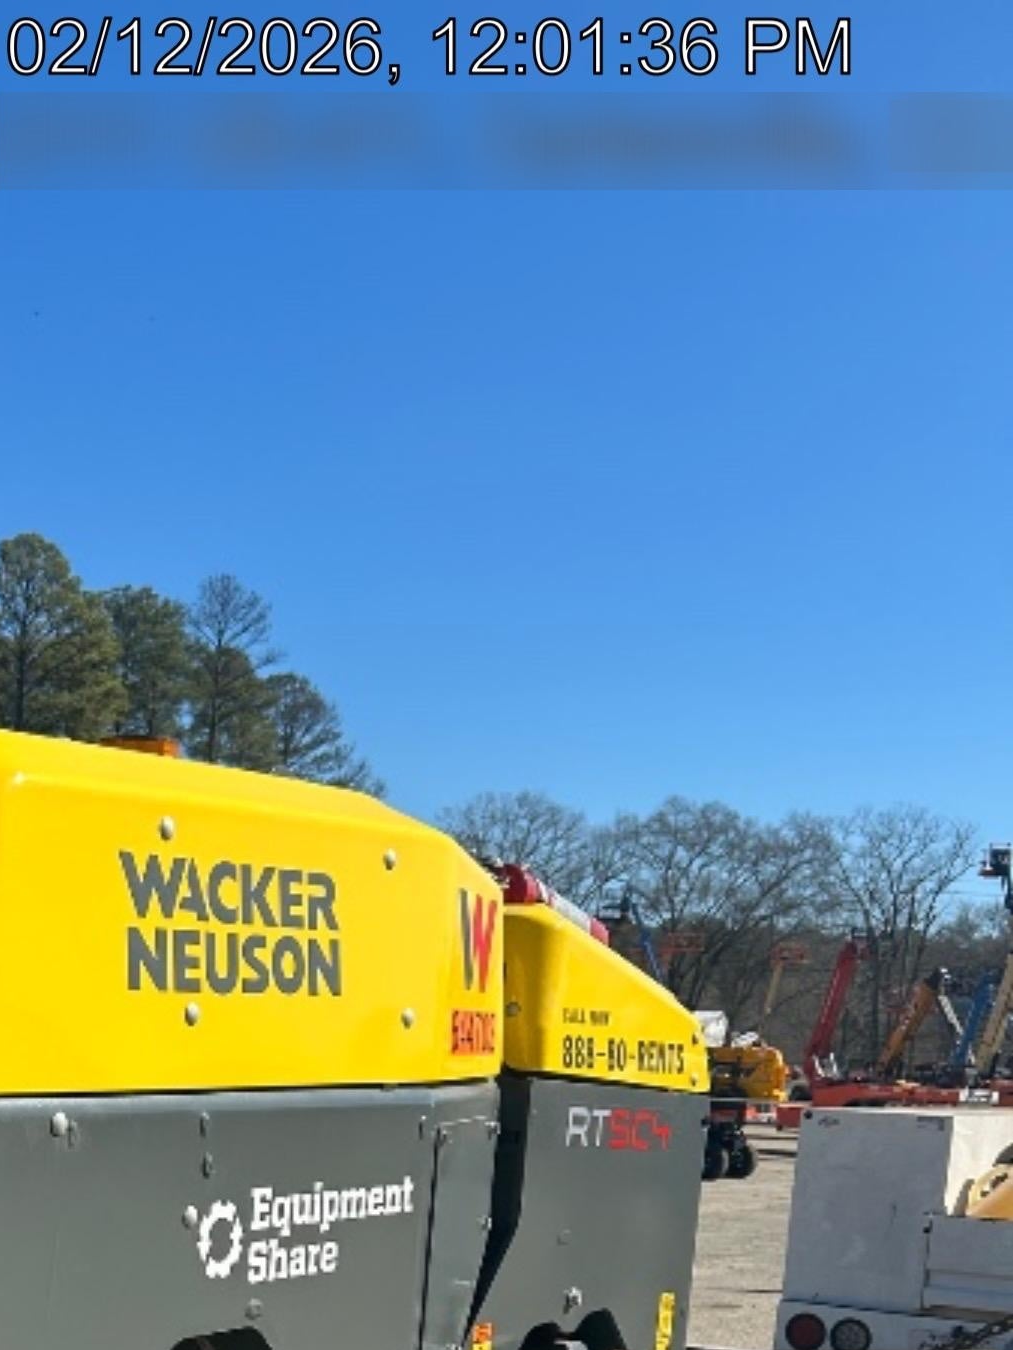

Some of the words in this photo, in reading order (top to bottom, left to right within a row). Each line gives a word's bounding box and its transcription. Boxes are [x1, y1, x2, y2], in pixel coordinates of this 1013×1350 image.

[119, 850, 340, 931] WACKER
[127, 926, 341, 996] NEUSON
[249, 1175, 414, 1237] Equipment
[247, 1238, 339, 1284] Share
